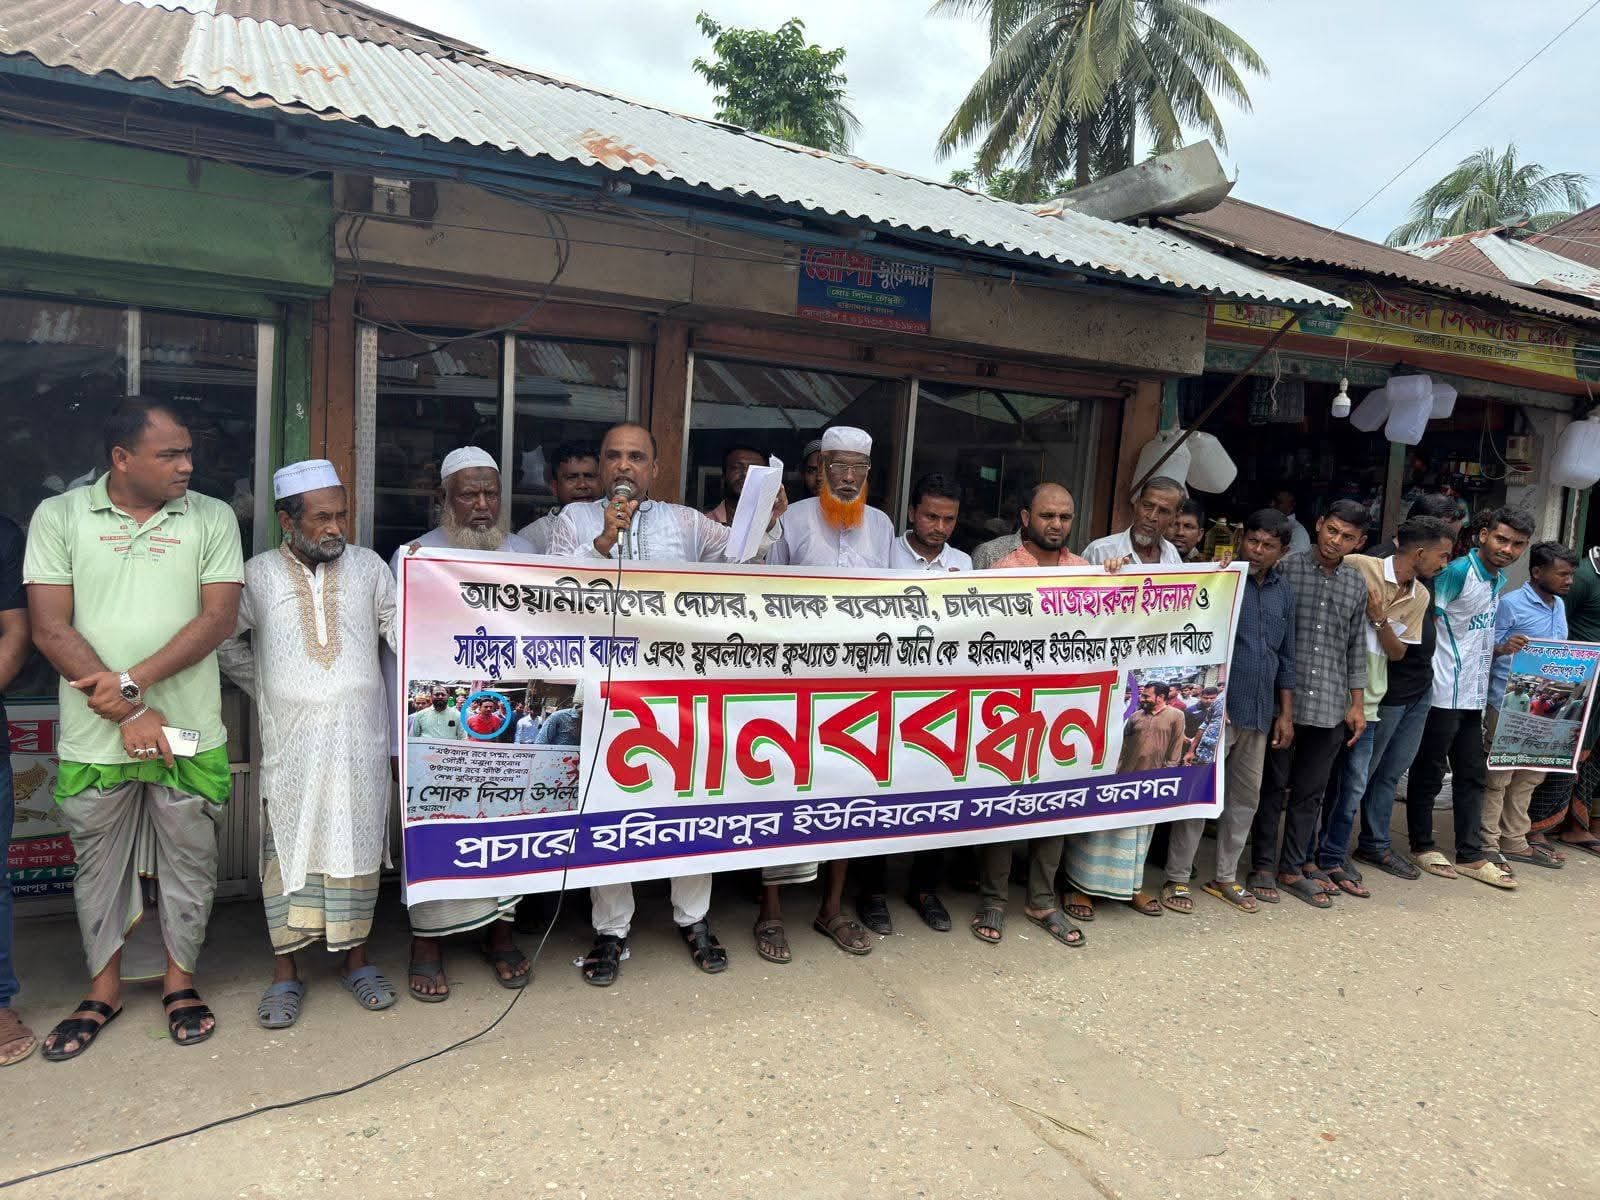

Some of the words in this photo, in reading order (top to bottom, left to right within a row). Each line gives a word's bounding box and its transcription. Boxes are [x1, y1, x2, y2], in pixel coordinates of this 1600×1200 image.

[459, 576, 666, 617] আওয়ামীলীগের
[674, 591, 758, 622] দোসর,
[761, 593, 828, 619] মাদক
[832, 585, 940, 621] ব্যবসায়ী,
[1036, 585, 1138, 618] মাজহারুল
[1140, 577, 1197, 616] ইসলাম
[1196, 588, 1210, 609] ও
[454, 625, 516, 680] সাইদুর
[521, 635, 585, 670] রহমান
[589, 636, 640, 668] বাদল
[644, 641, 685, 670] এবং
[691, 632, 779, 676] যুবলীগের
[782, 642, 840, 676] কুখ্যাত
[896, 625, 934, 667] জনি
[937, 640, 959, 665] কে
[968, 631, 1046, 672] হরিনাথপুর
[1049, 629, 1108, 666] ইউনিয়ন
[1110, 635, 1136, 668] মুক্ত
[1136, 633, 1169, 657] করার
[1170, 623, 1214, 657] দাবীতে
[600, 669, 1121, 797] মানববন্ধন
[419, 785, 472, 802] শোক
[476, 781, 525, 803] দিবস
[530, 782, 578, 801] উপল
[453, 828, 579, 868] প্রচারে
[591, 812, 783, 852] হরিনাথপুর
[792, 798, 963, 835] ইউনিয়নের
[970, 788, 1091, 819] সর্বস্তরের
